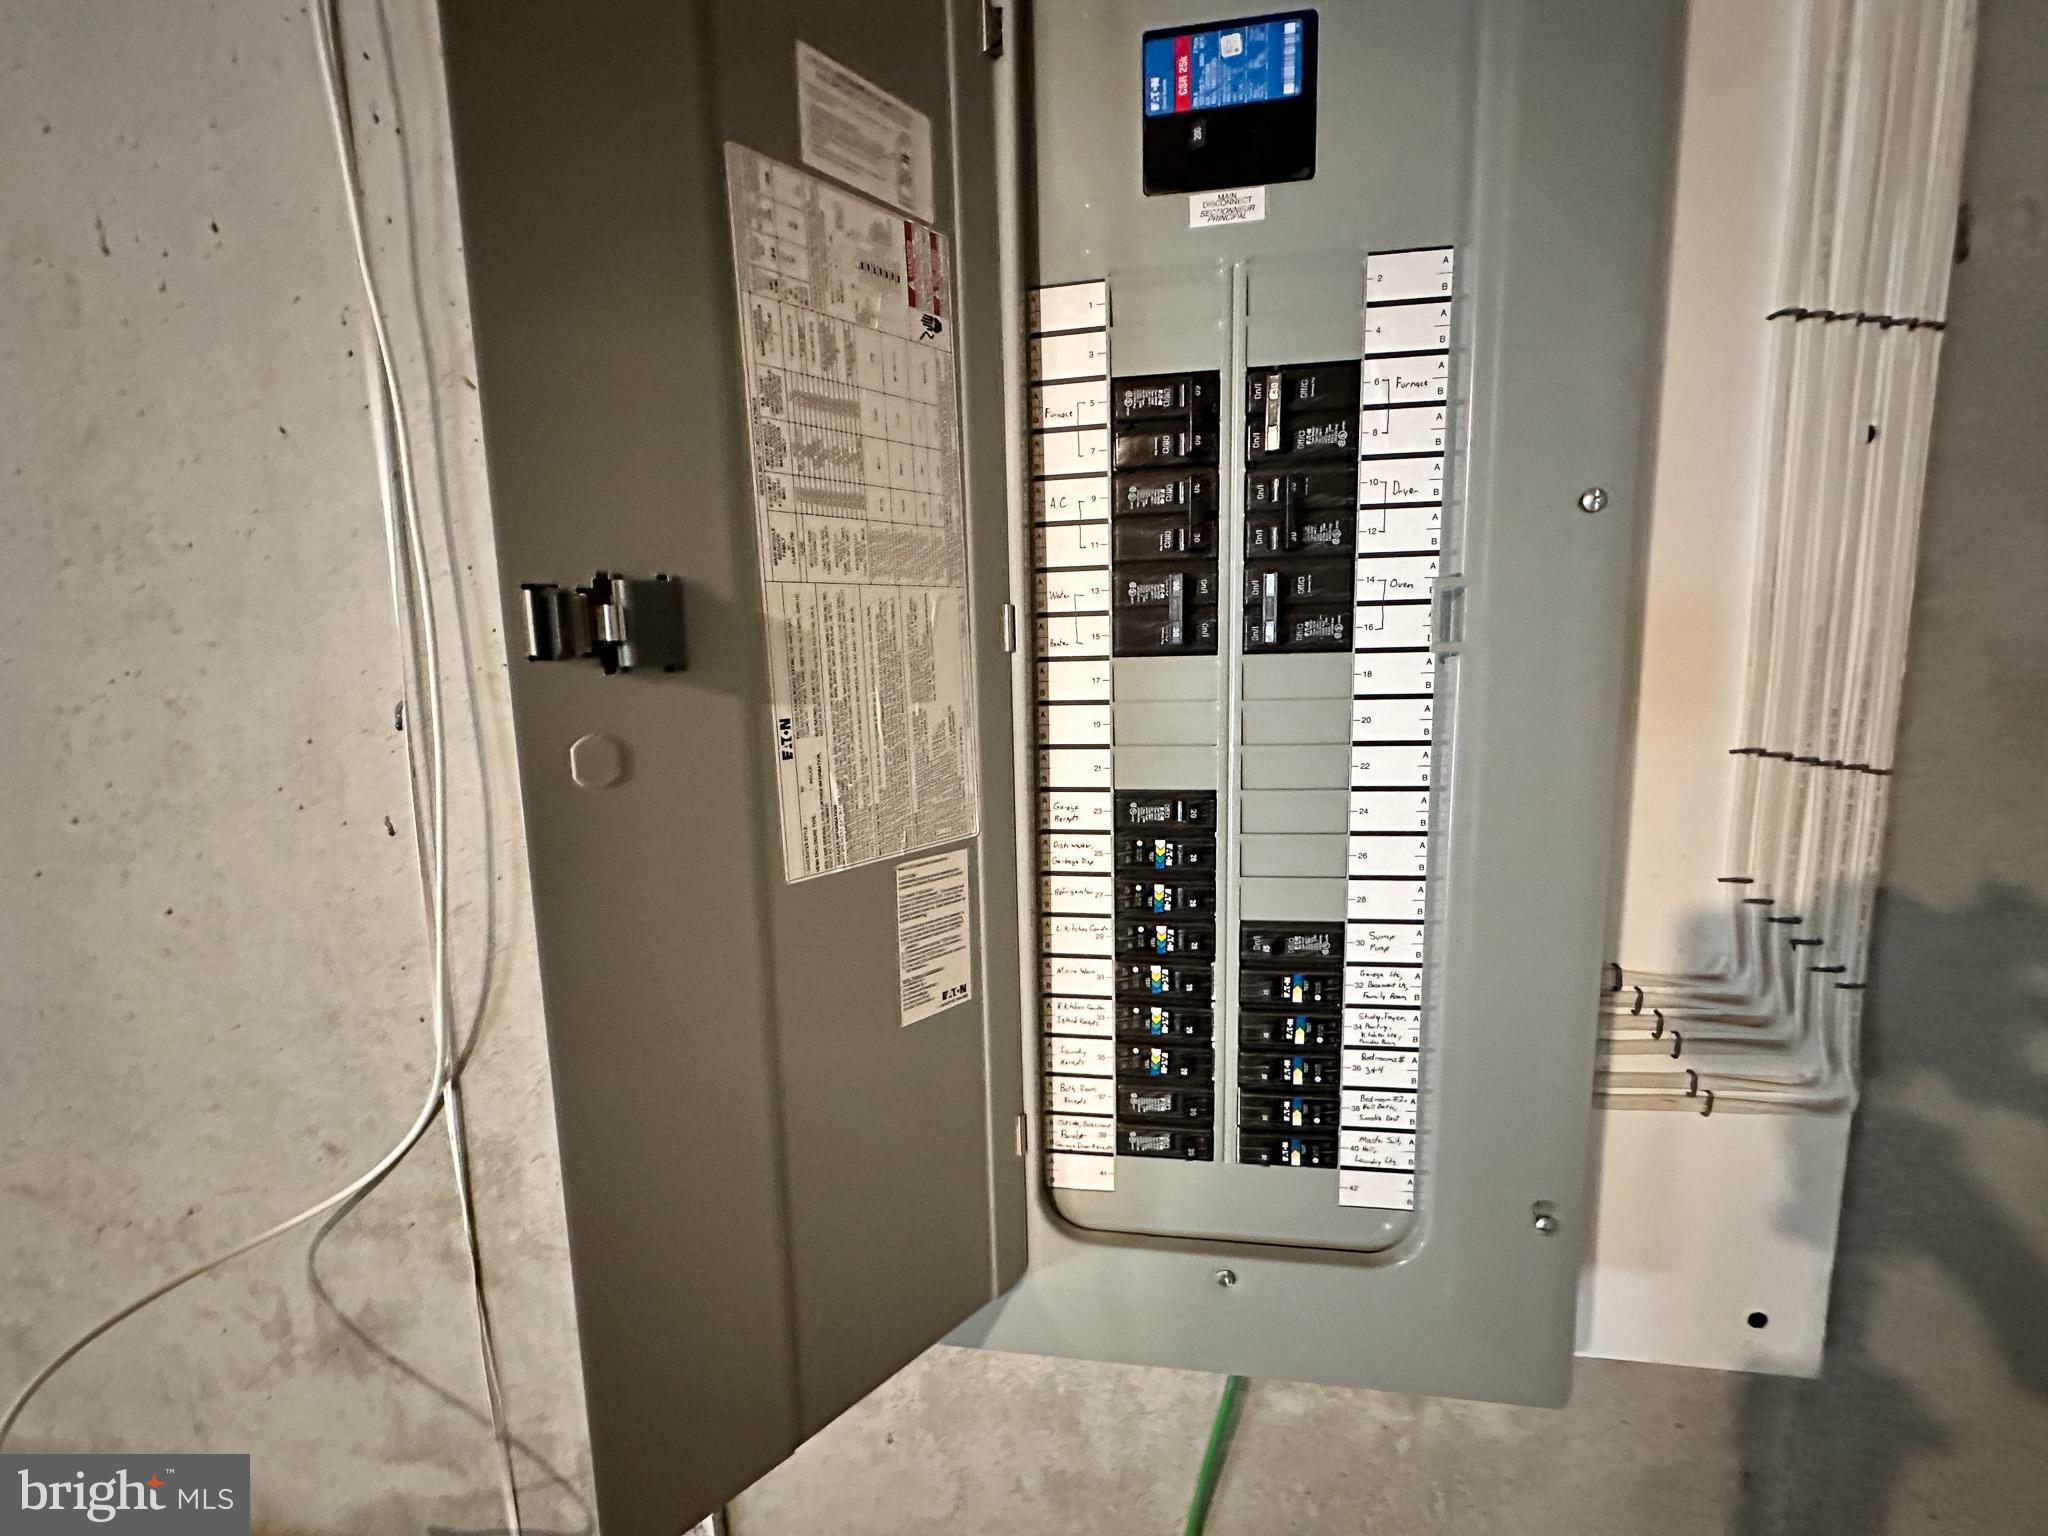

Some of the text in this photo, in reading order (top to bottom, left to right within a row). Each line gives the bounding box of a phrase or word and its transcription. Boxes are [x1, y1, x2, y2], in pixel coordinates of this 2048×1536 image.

[1178, 55, 1188, 96] CSR 25k
[1193, 126, 1202, 141] 200
[1217, 192, 1237, 200] MAIN
[1203, 196, 1252, 209] DISCONNECT
[1200, 204, 1256, 218] SECTIONNEUR
[1207, 213, 1246, 222] PRINCIPAL
[1396, 377, 1428, 389] Furnace
[1045, 408, 1073, 419] Furnace
[1392, 480, 1418, 496] Dryer
[1390, 579, 1414, 589] Oven
[1049, 589, 1069, 600] Water
[779, 718, 793, 761] EATON
[1053, 802, 1079, 812] Garage
[1052, 857, 1079, 866] Garbage
[1369, 931, 1395, 940] Sump
[1370, 944, 1390, 953] Pump
[1360, 970, 1383, 979] Garage
[941, 983, 967, 1001] EATON
[1363, 992, 1385, 1000] Family
[1360, 1094, 1391, 1102] Bedroom
[1355, 1155, 1381, 1166] Laundry
